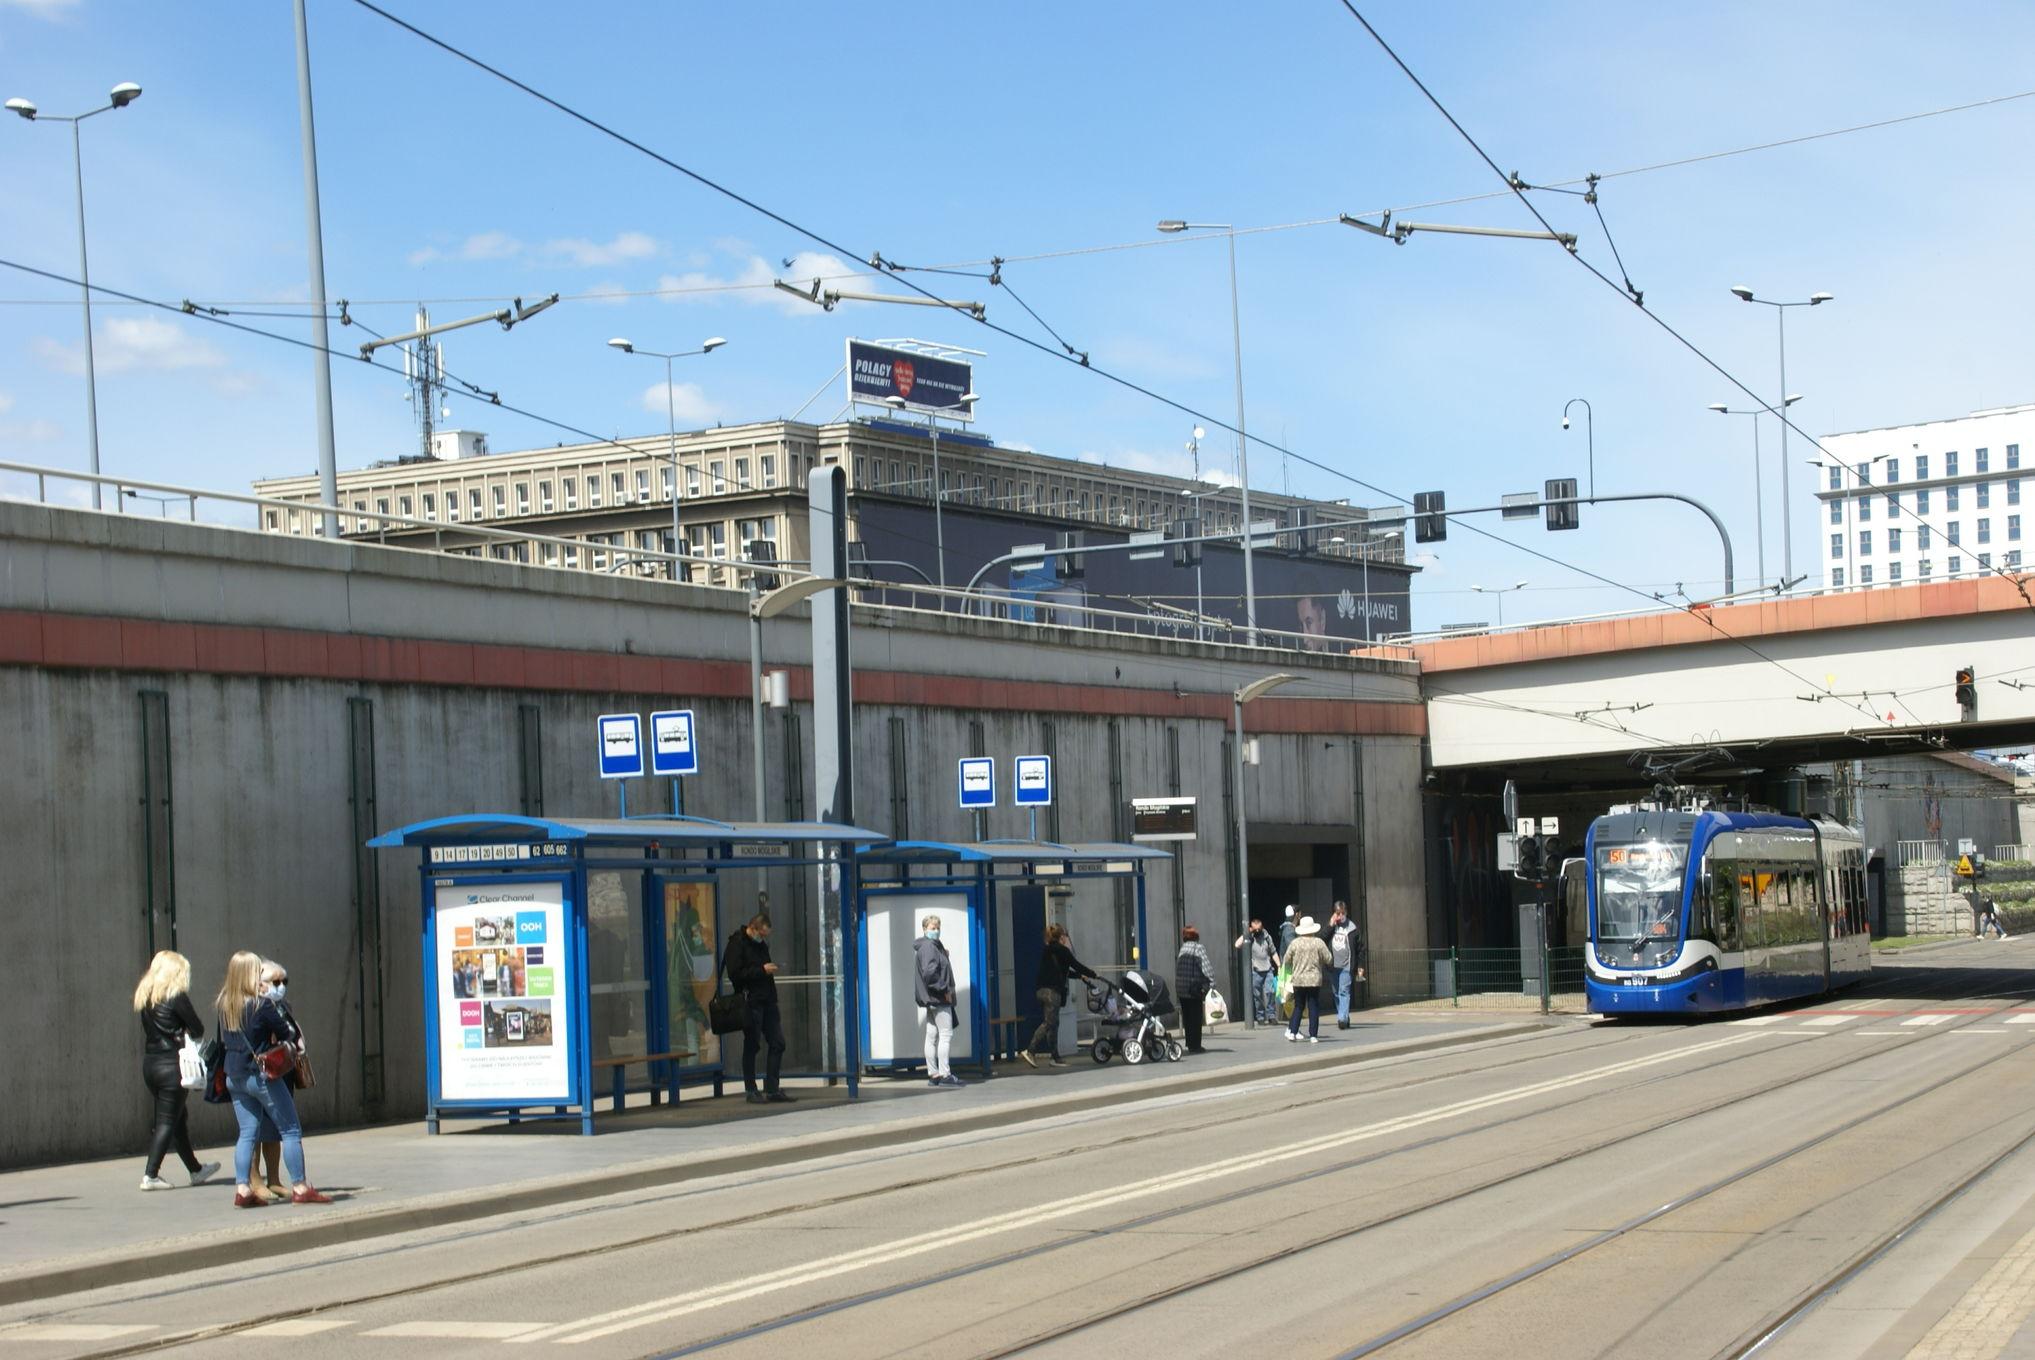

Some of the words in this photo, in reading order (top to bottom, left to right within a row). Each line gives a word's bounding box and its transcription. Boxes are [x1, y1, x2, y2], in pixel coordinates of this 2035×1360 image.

[855, 360, 892, 377] POLACY
[1357, 600, 1398, 621] HUAWEI
[434, 851, 439, 860] 9
[446, 850, 453, 860] 14
[458, 850, 466, 859] 17
[471, 850, 478, 859] 19
[483, 849, 491, 858] 20
[496, 848, 503, 857] 49
[508, 847, 515, 856] 50
[533, 846, 540, 856] 62
[1611, 850, 1625, 862] 50
[480, 894, 500, 904] Clear
[502, 893, 534, 903] Channel
[520, 922, 542, 931] OOH
[1632, 977, 1648, 986] 907
